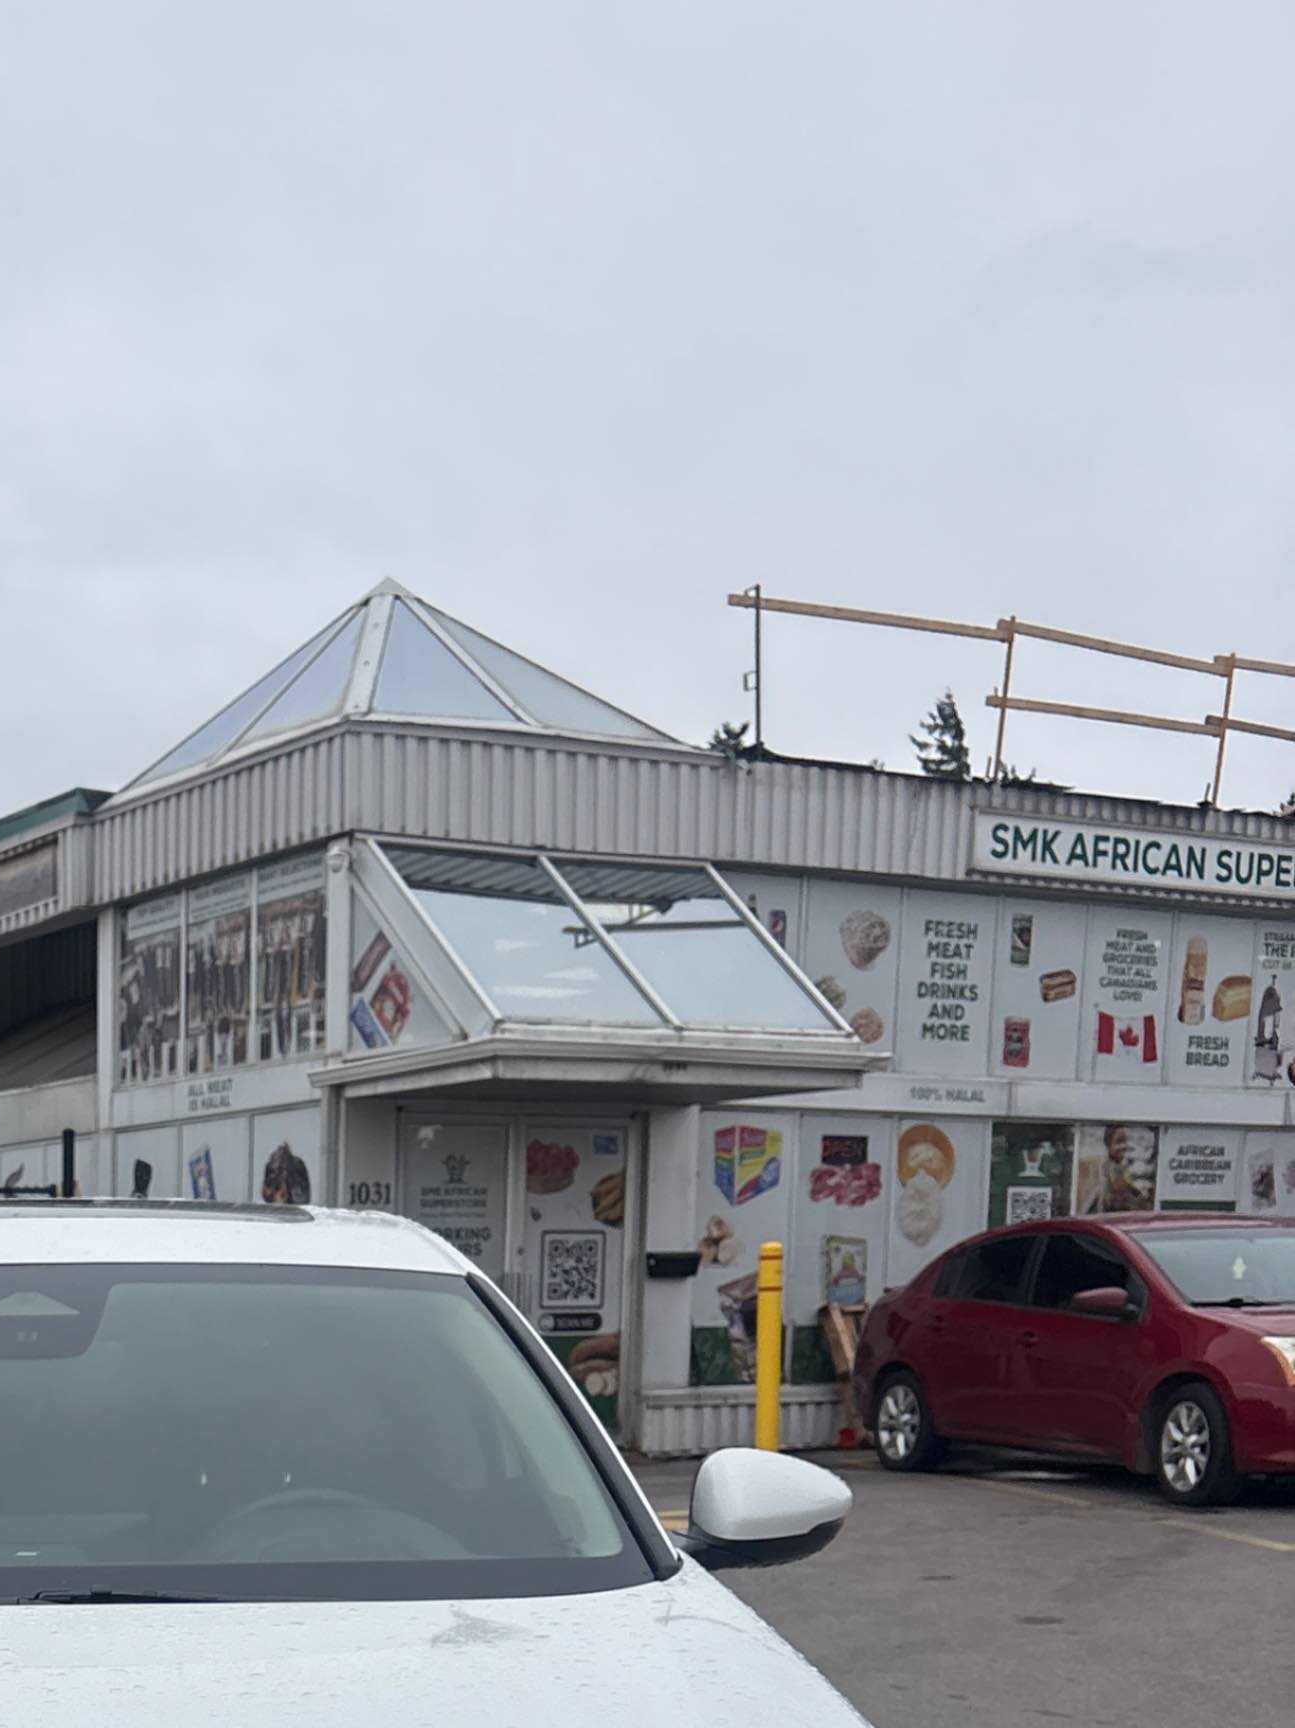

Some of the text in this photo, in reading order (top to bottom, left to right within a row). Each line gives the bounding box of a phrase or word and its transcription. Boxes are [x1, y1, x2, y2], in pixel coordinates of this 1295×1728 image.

[990, 822, 1295, 887] SMK AFRICAN SUPE
[924, 919, 978, 940] FRESH
[926, 940, 974, 960] MEAT
[1264, 943, 1288, 958] THE
[930, 961, 968, 980] FISH
[917, 981, 978, 1002] DRINKS
[927, 1002, 965, 1021] AND
[921, 1022, 970, 1042] MORE
[1188, 1035, 1229, 1051] FRESH
[1185, 1051, 1230, 1068] BREAD
[349, 1181, 392, 1206] 1031
[431, 1227, 492, 1242] ORKING
